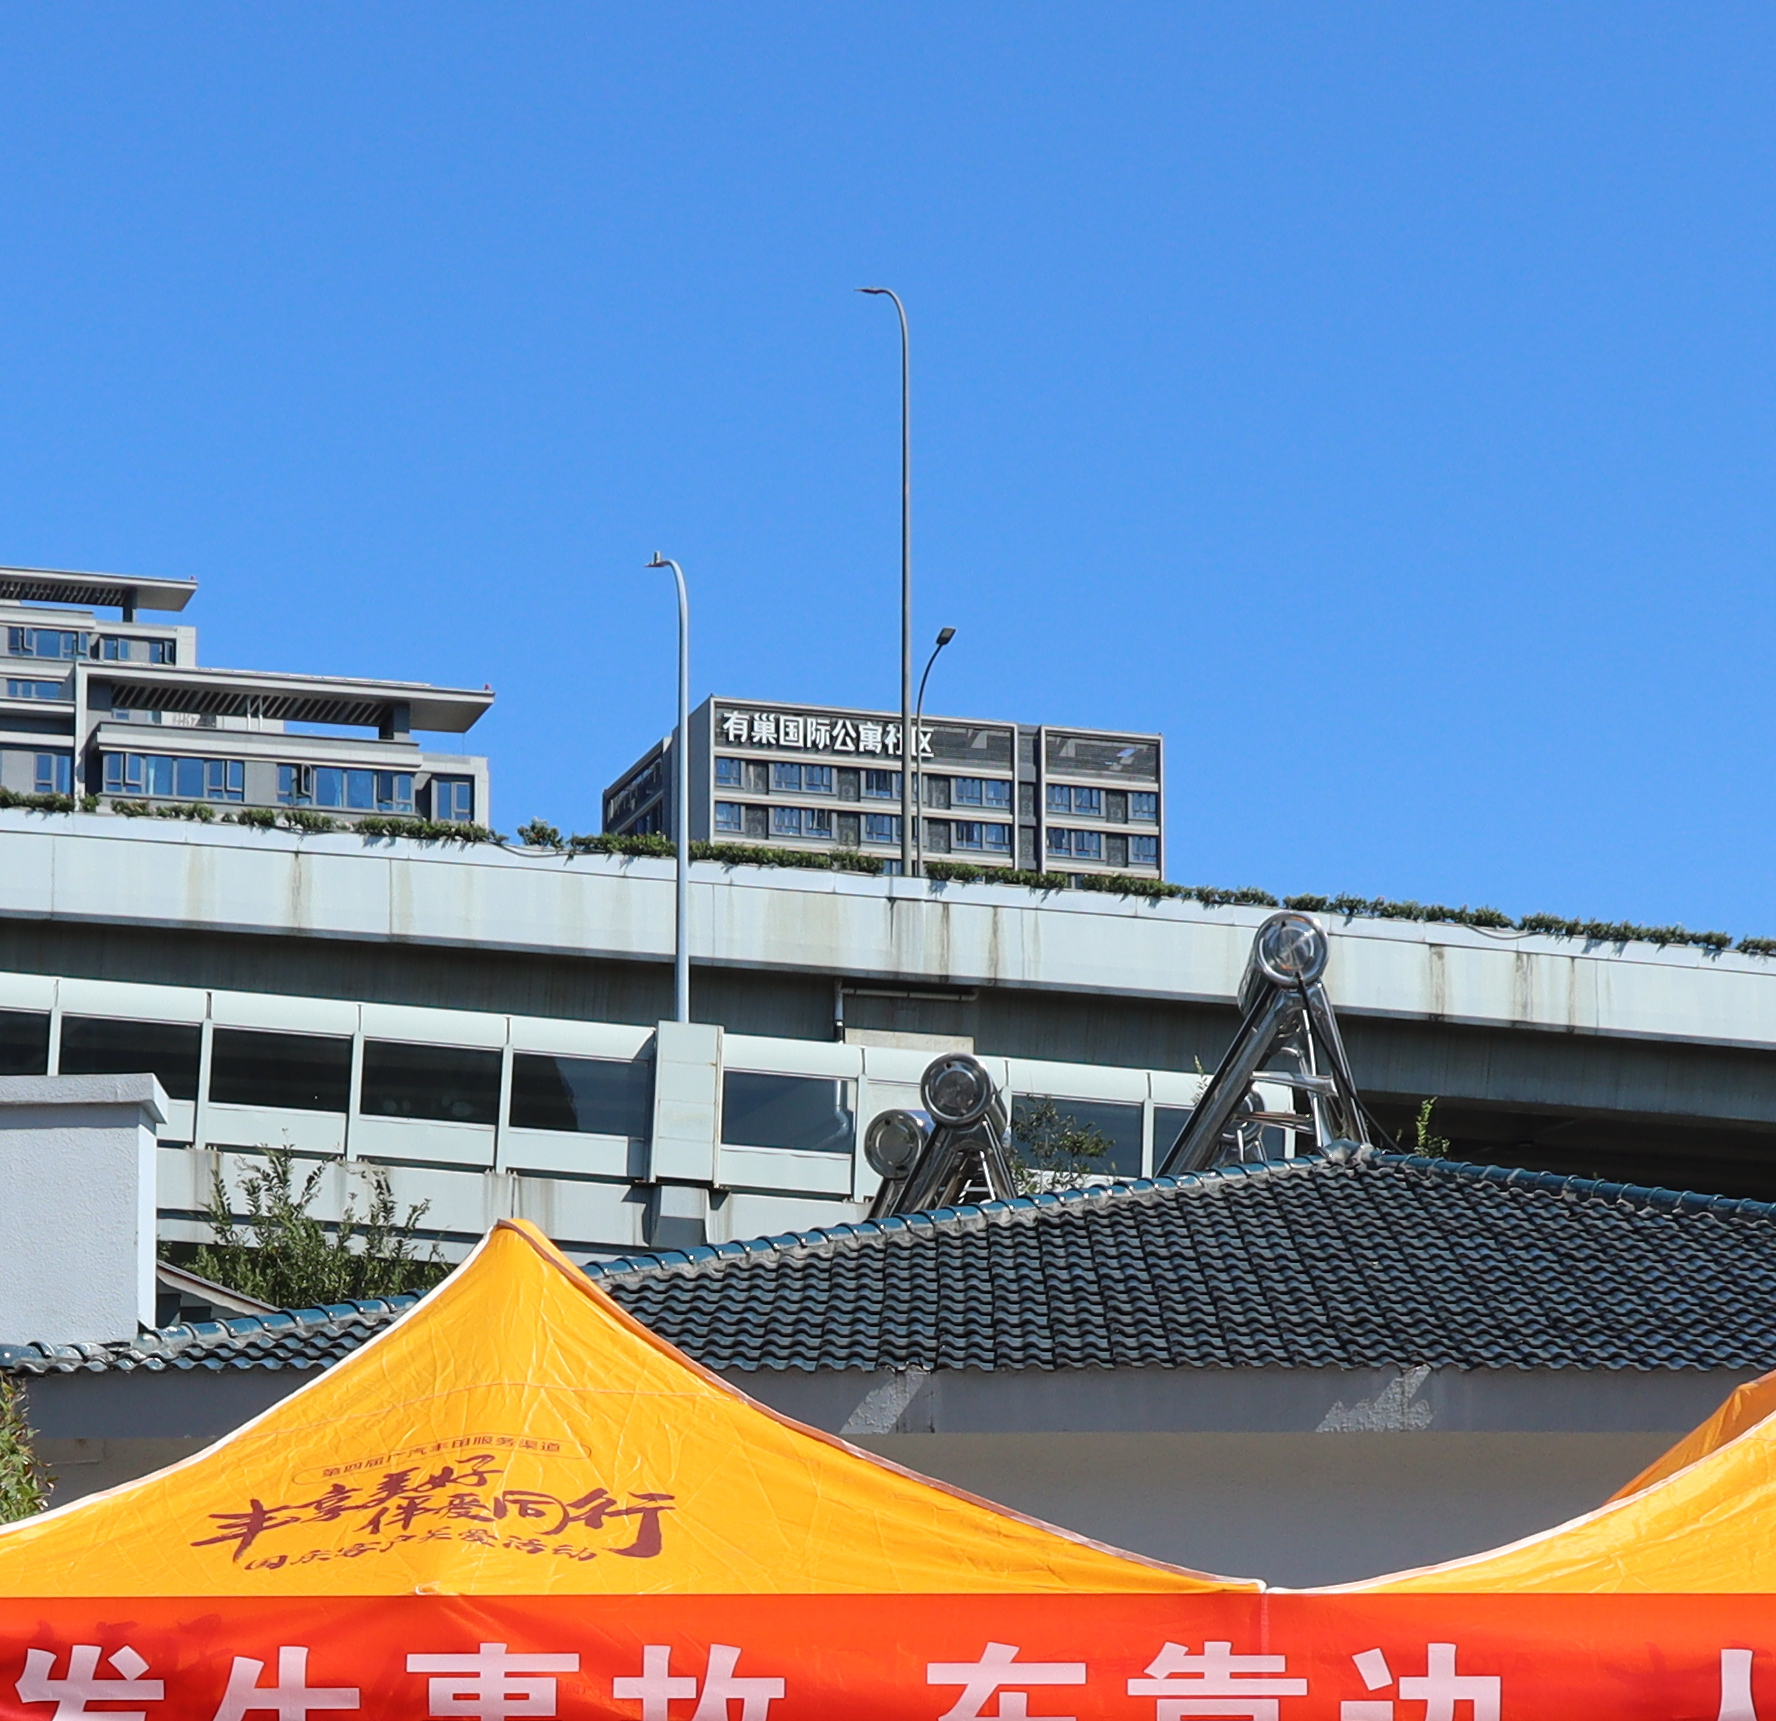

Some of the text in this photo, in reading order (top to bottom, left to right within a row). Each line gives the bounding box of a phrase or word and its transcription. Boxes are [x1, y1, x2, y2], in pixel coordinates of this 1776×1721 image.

[722, 710, 935, 758] 有巢国际公寓社区
